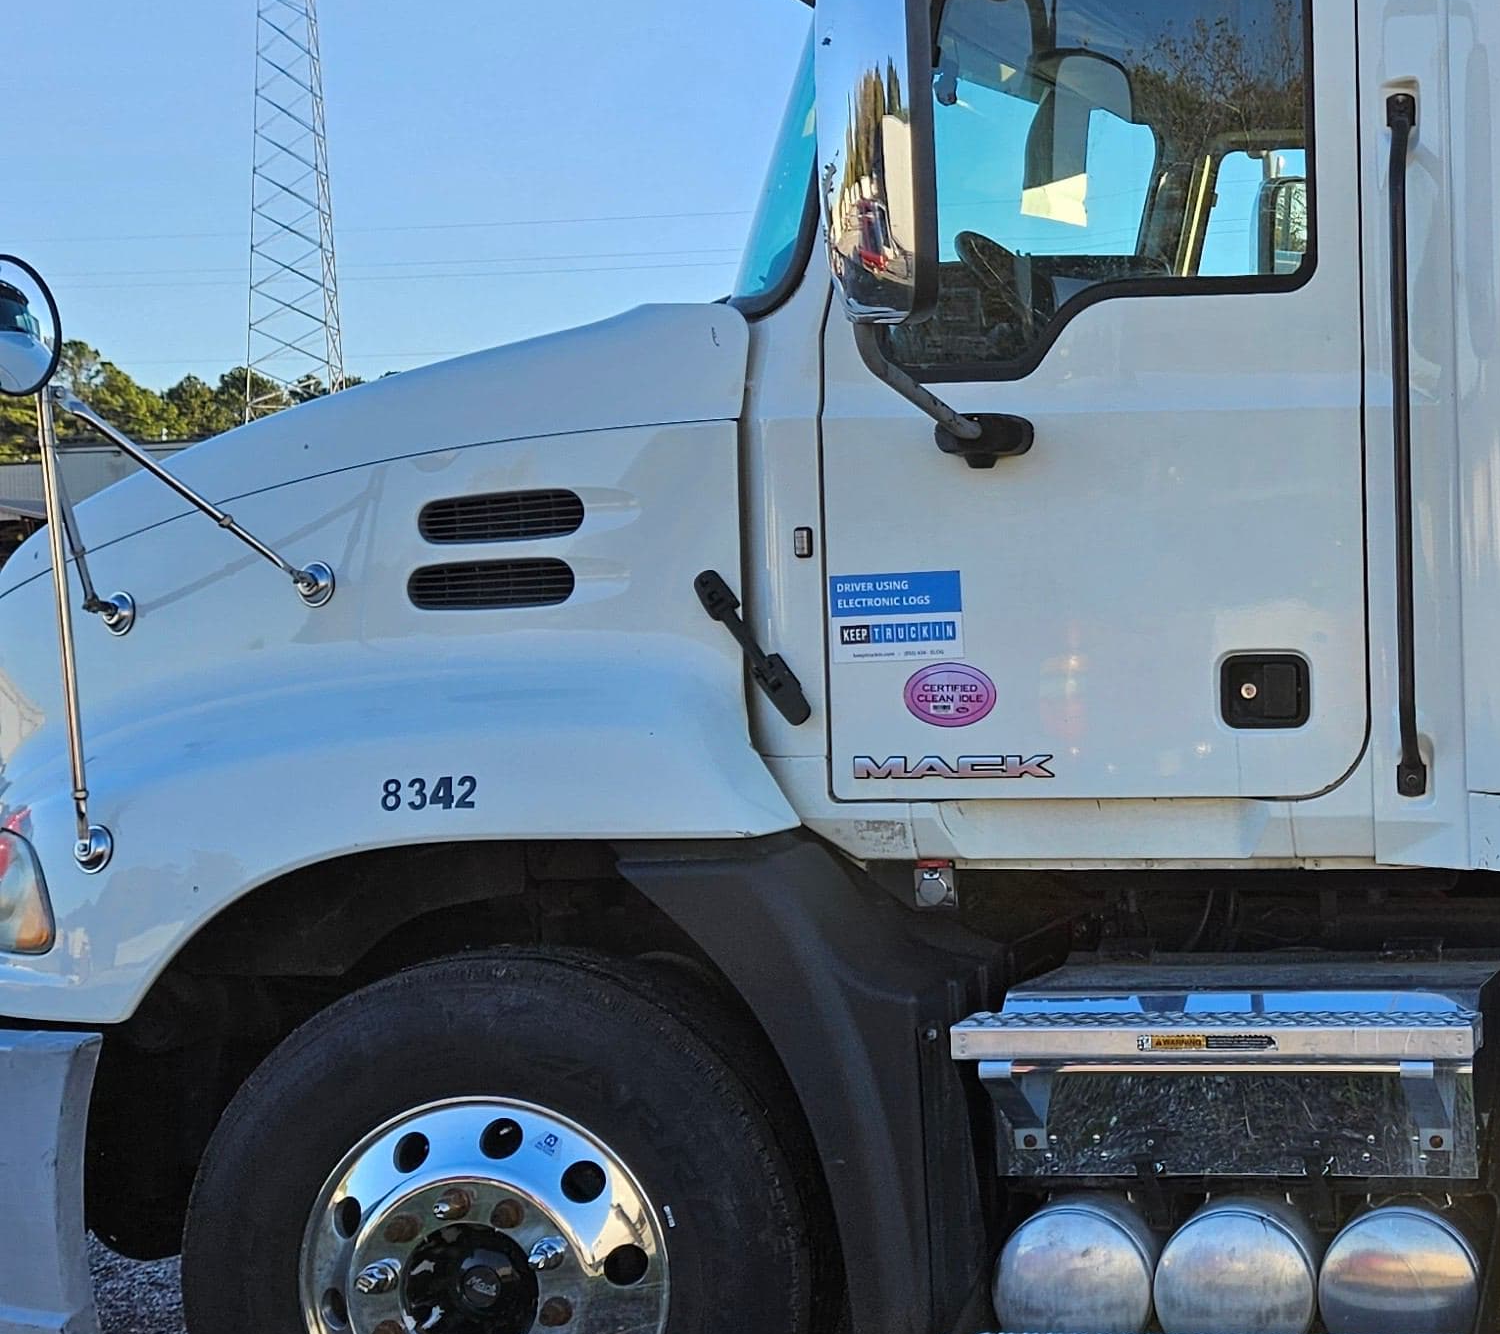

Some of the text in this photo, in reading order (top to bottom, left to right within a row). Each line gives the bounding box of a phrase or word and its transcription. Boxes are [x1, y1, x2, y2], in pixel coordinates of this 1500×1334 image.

[836, 580, 909, 593] DRIVER USING
[837, 595, 931, 609] ELECTRONIC LOGS
[842, 624, 954, 642] KEEP TRUCKIN
[922, 684, 978, 693] CERTIFIED
[917, 694, 984, 703] CLEAN IDLE
[853, 754, 1056, 780] MACK
[380, 775, 478, 812] 8342
[1162, 1039, 1202, 1047] WARNING
